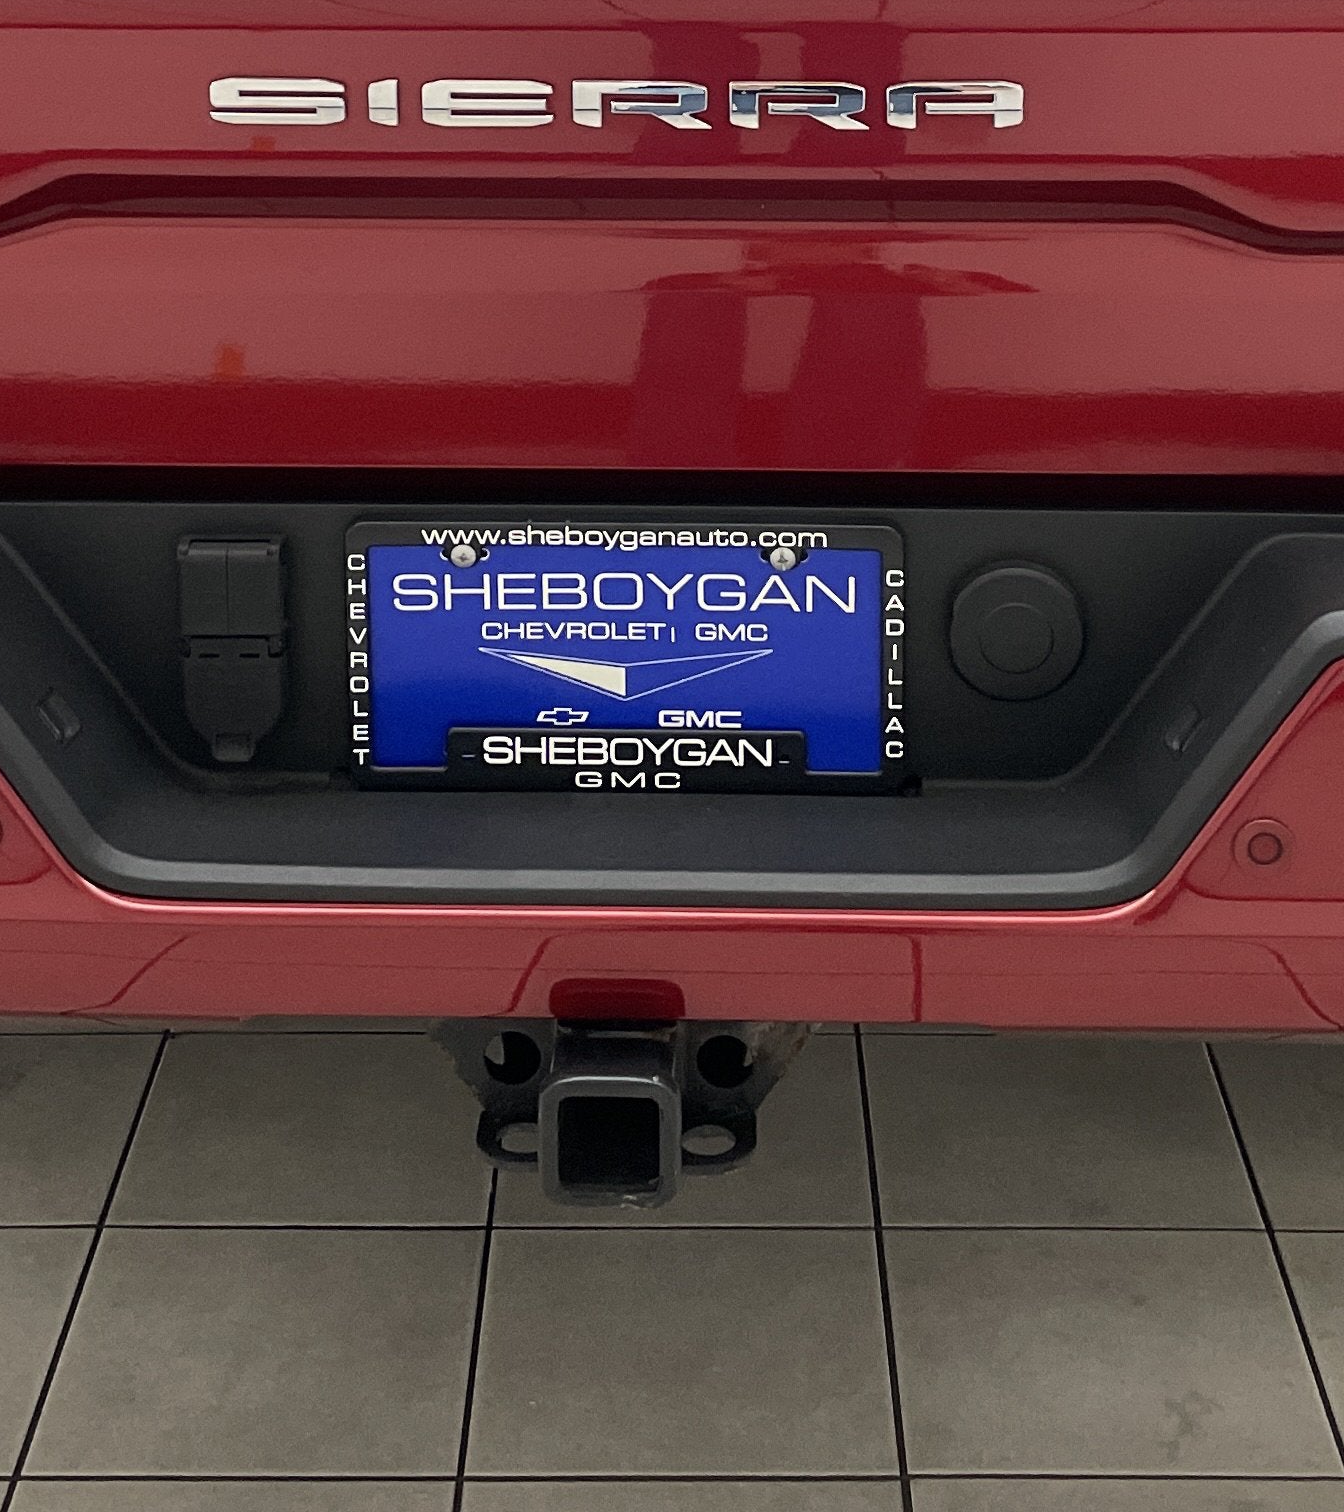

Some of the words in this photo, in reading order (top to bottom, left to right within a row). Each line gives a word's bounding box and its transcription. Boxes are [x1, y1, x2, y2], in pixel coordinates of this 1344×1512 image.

[208, 76, 1025, 131] SIERRA
[422, 526, 828, 551] www.sheboyganauto.com
[392, 572, 857, 613] SHEBOYGAN
[481, 622, 667, 642] CHEVROLET
[695, 623, 769, 643] GMC
[346, 554, 371, 766] CHEVROLET
[884, 569, 905, 759] CADILLAC
[657, 709, 743, 729] GMC
[482, 735, 773, 768] SHEBOYGAN
[574, 771, 682, 790] GMC
